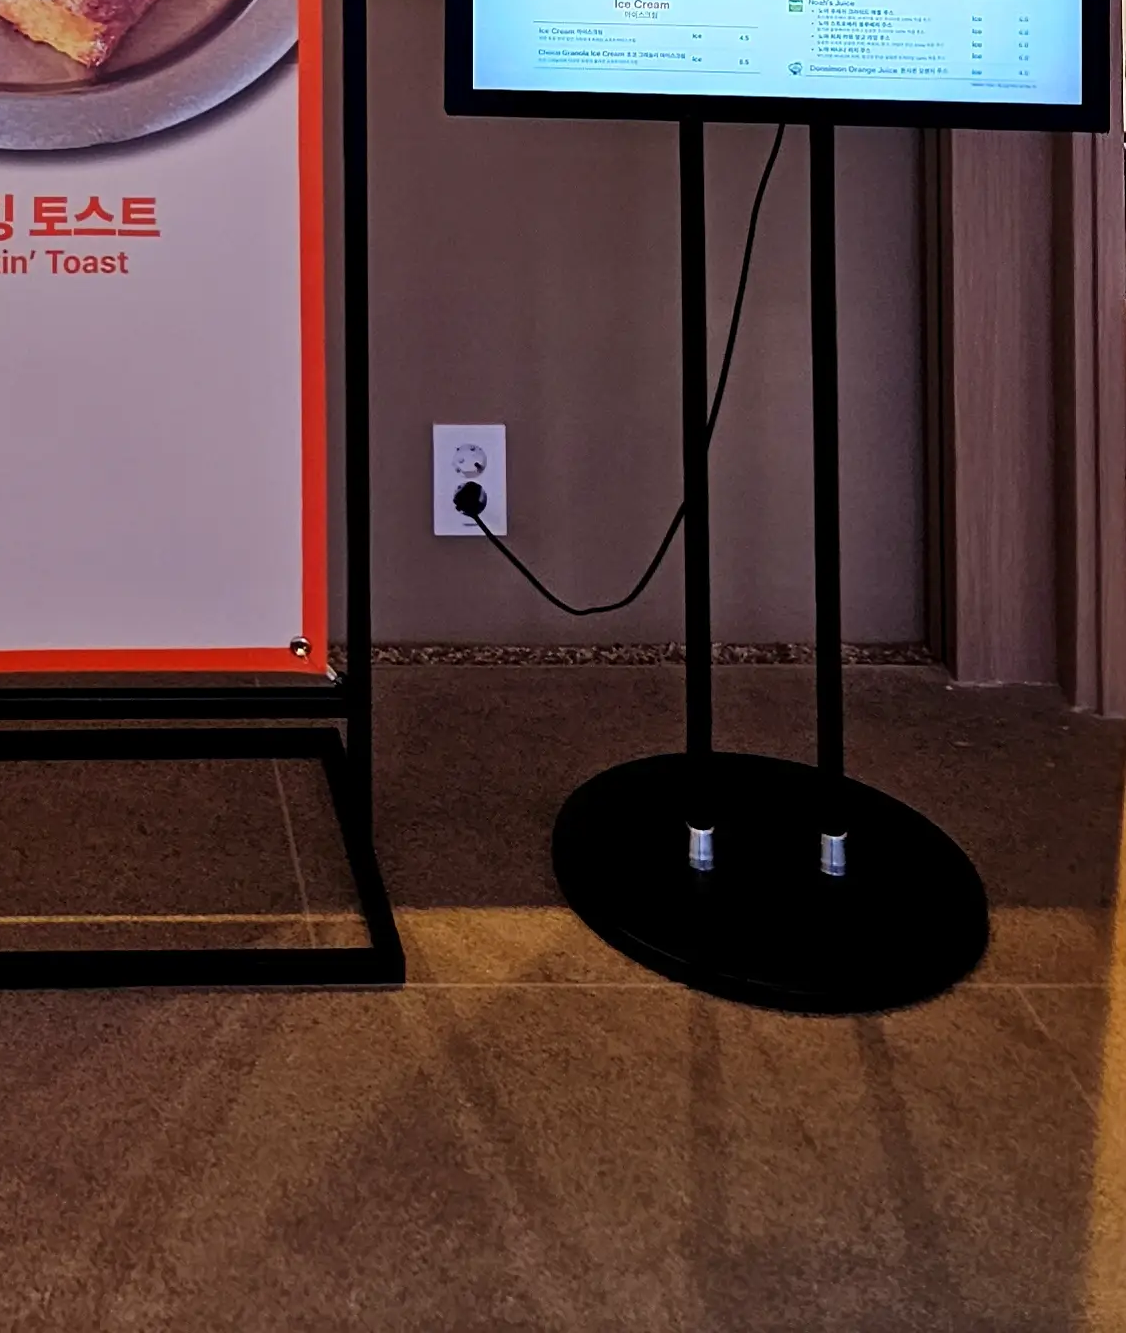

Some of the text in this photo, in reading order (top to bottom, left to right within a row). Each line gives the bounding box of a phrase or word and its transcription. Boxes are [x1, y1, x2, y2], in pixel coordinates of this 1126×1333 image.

[614, 0, 670, 9] Ice Cream
[28, 197, 161, 239] 토스트
[44, 249, 129, 276] Toast
